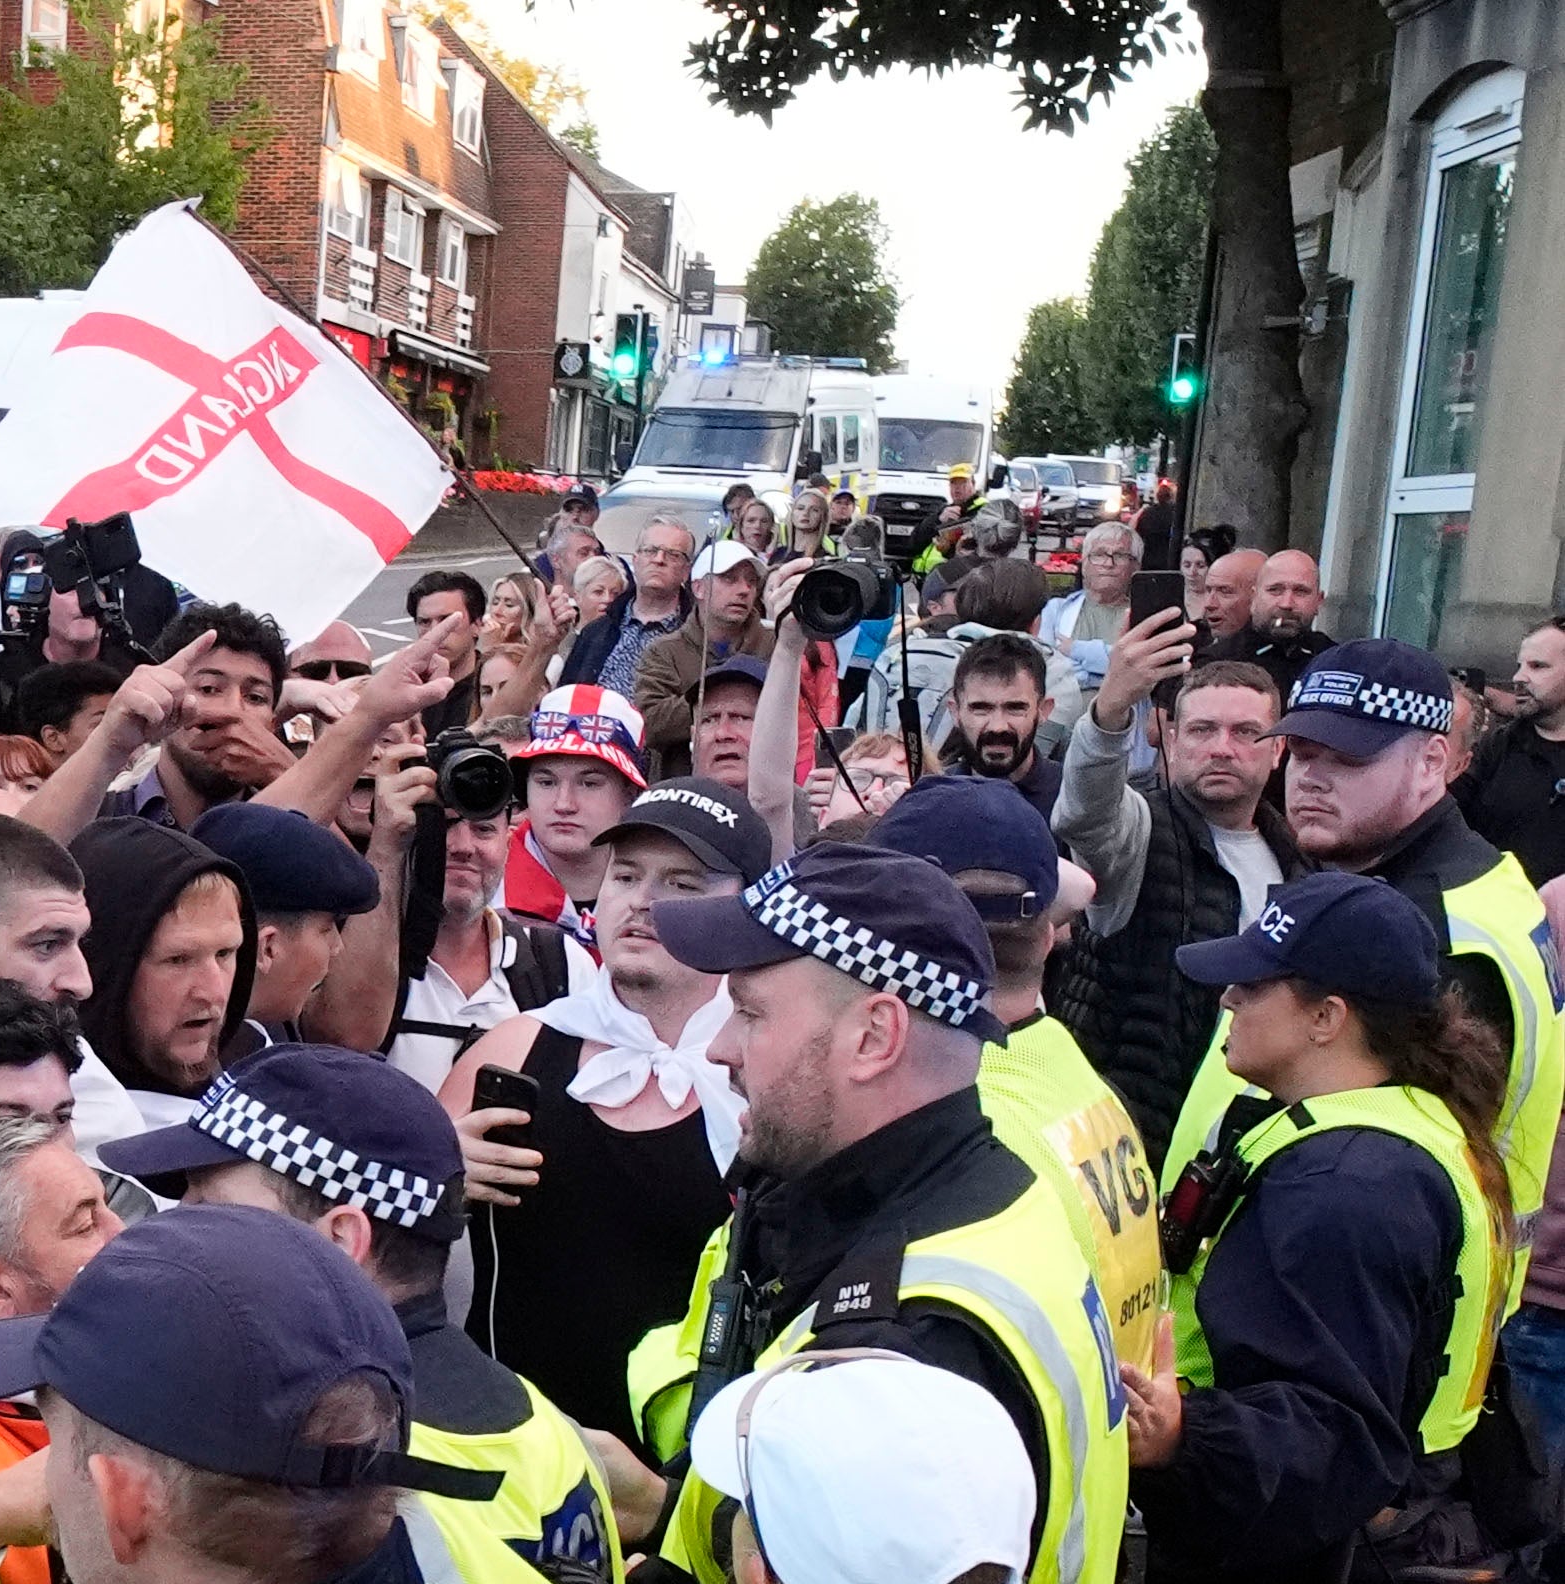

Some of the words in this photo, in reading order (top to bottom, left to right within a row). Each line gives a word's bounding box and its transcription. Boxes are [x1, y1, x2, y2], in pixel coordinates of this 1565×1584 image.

[1320, 692, 1355, 706] OFFICER
[1079, 1134, 1150, 1237] VG
[838, 1281, 871, 1301] NW
[833, 1295, 872, 1314] 1948
